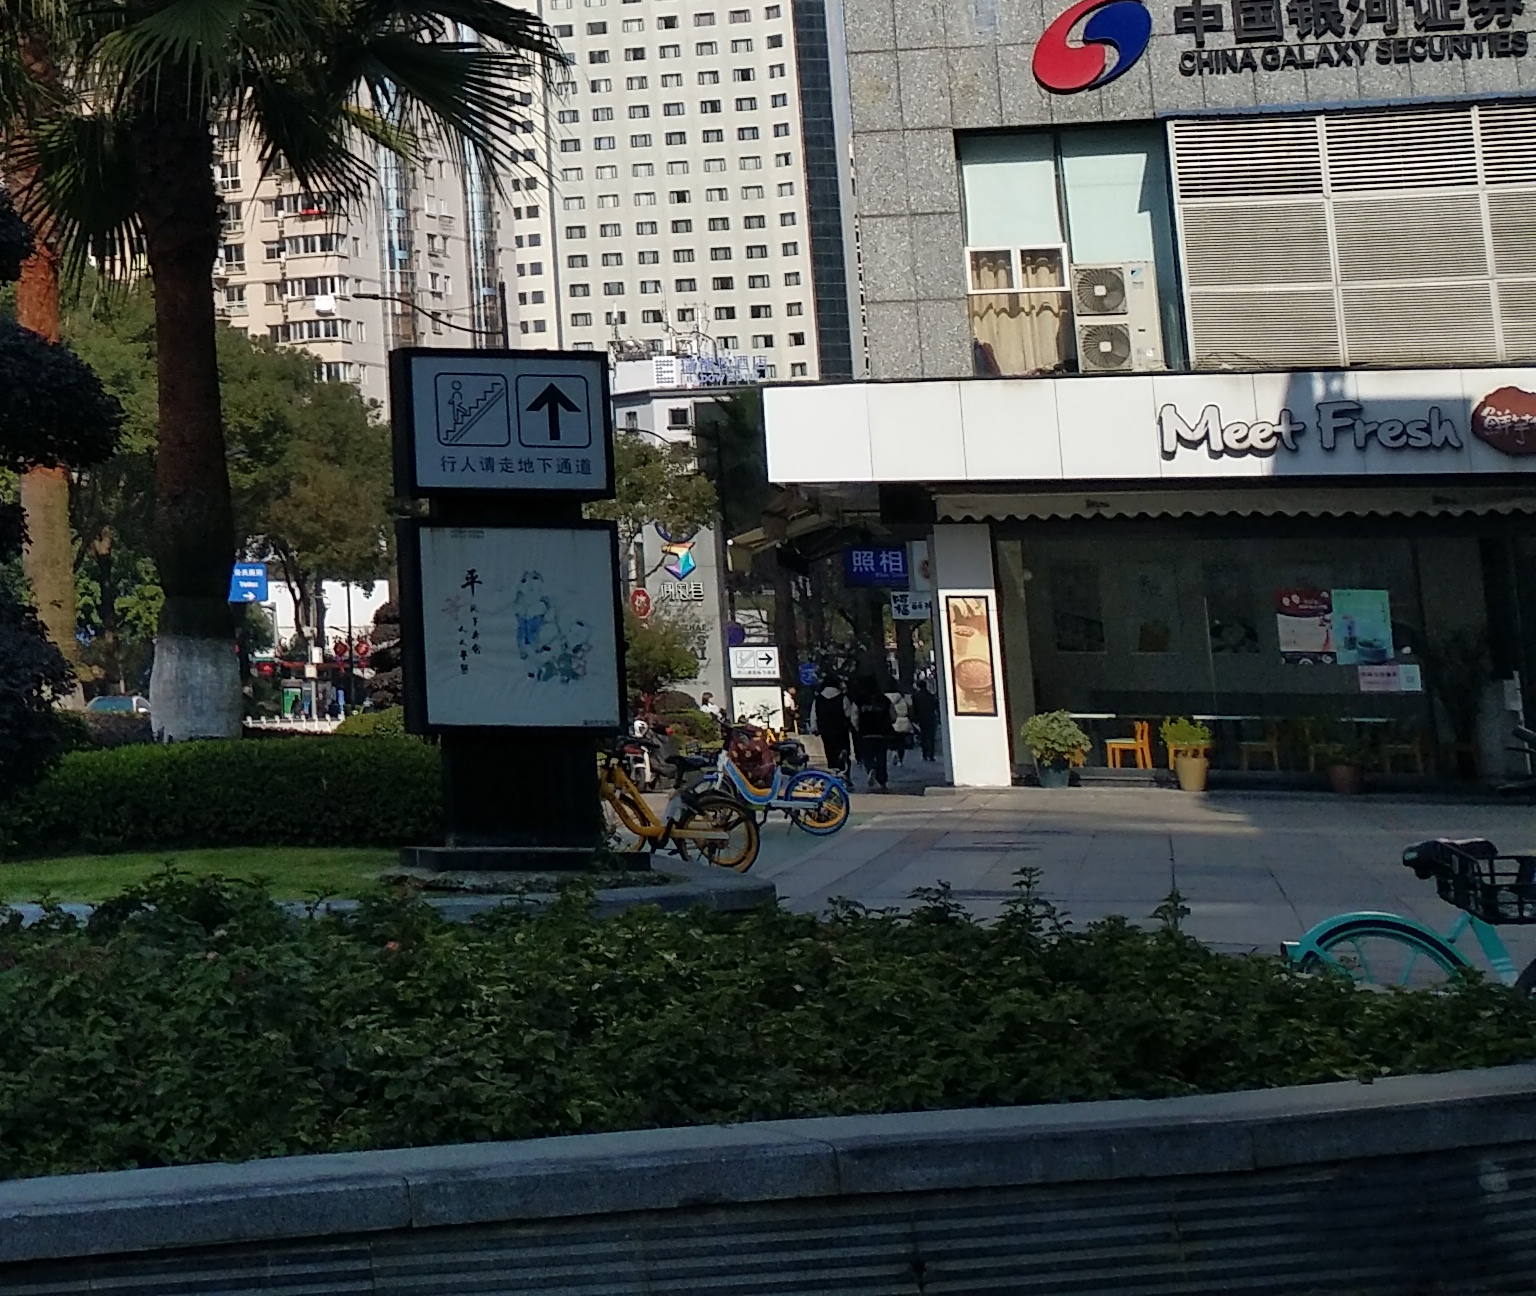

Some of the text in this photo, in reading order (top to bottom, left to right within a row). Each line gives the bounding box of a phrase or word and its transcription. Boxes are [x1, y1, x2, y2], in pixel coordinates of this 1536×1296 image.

[1178, 30, 1529, 77] CHINA GALAXY SECURITIES
[1158, 400, 1464, 460] Meet Fresh
[441, 456, 593, 475] 行人请走地下通道
[852, 550, 904, 572] 照相
